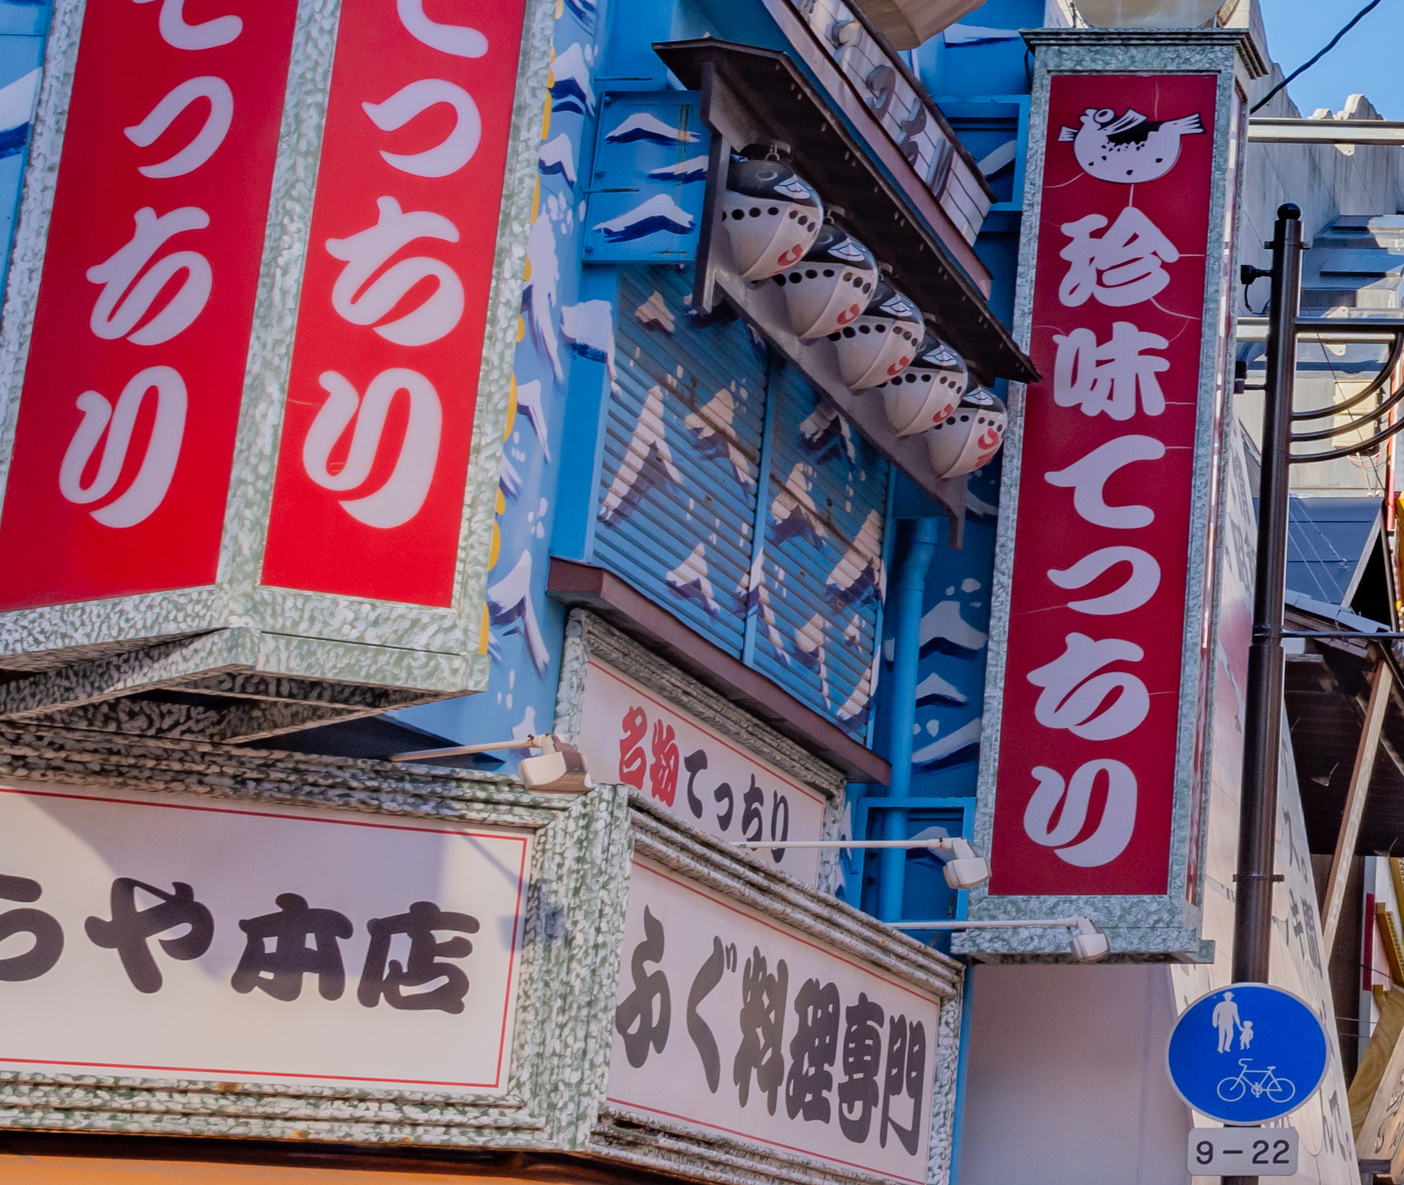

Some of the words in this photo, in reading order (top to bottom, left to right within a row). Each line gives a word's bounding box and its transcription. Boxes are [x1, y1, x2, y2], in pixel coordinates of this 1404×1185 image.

[615, 904, 926, 1157] ふぐ料理専門
